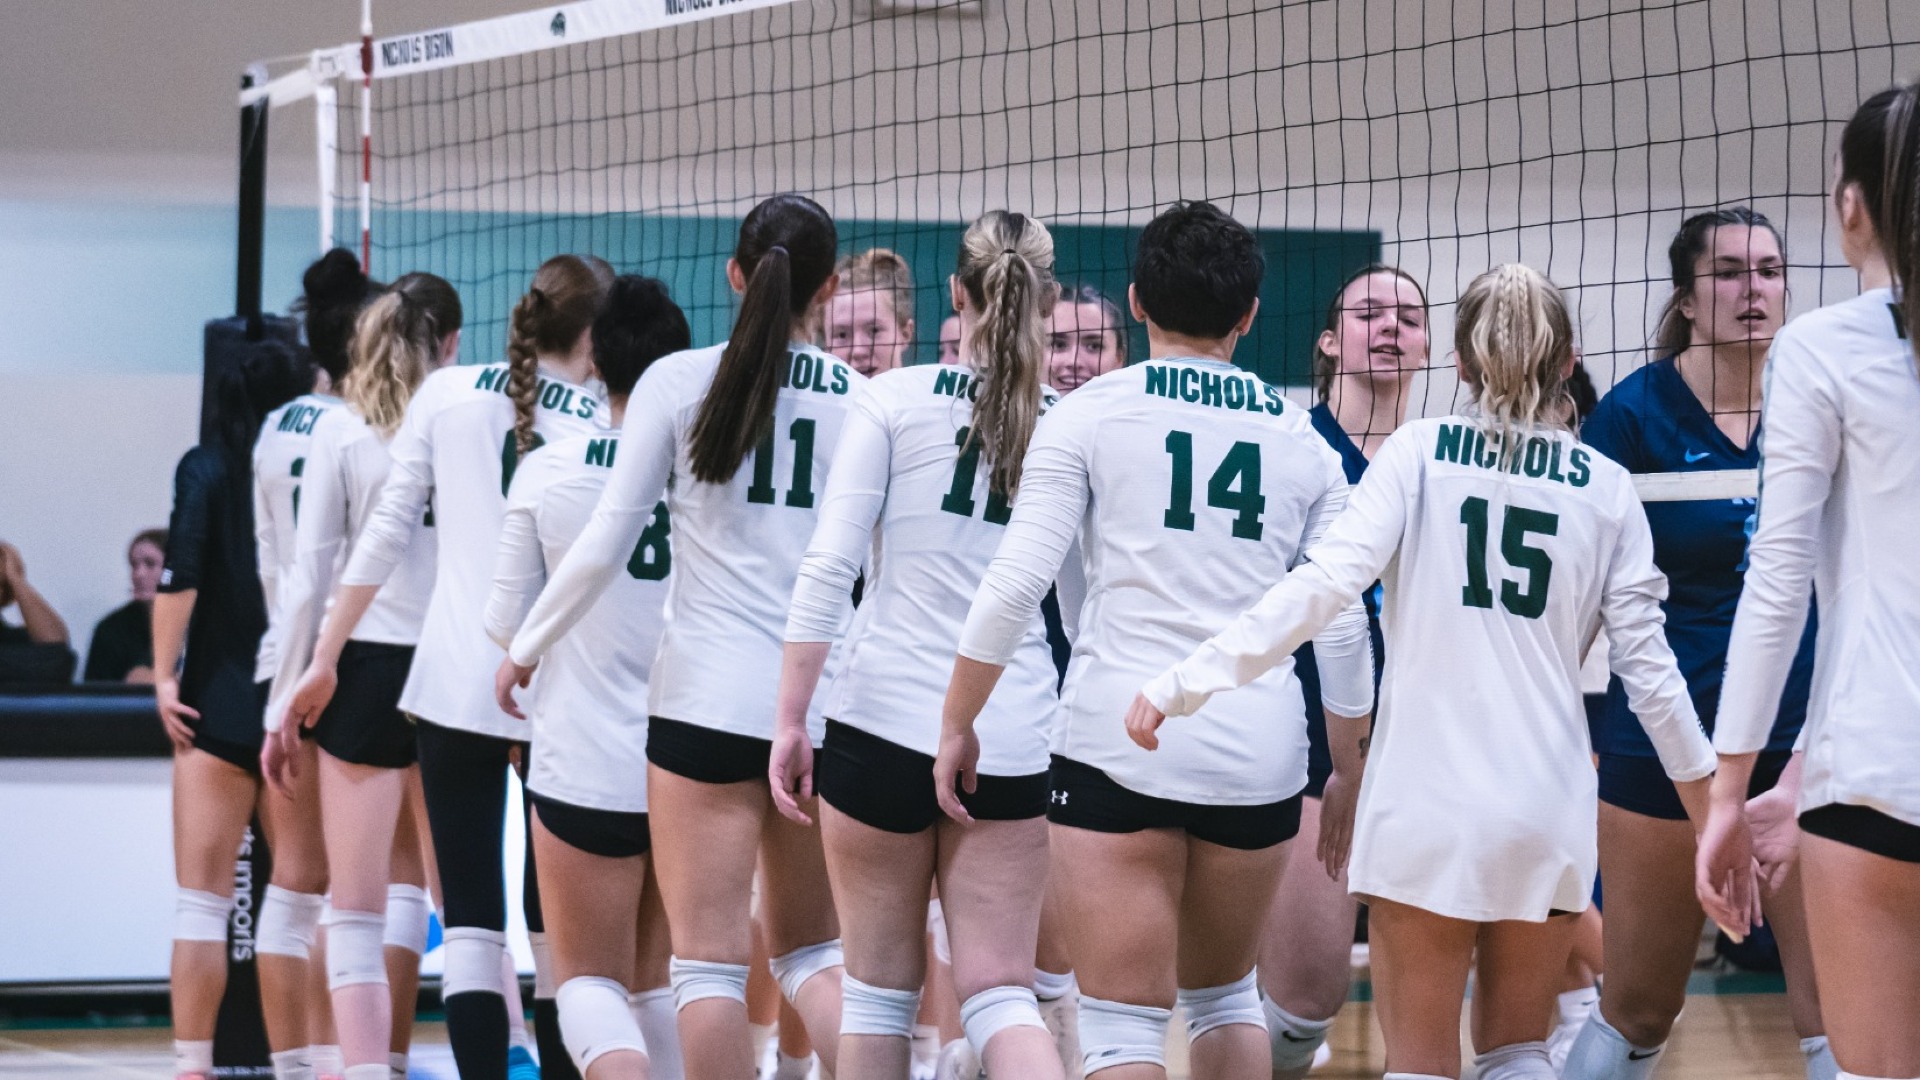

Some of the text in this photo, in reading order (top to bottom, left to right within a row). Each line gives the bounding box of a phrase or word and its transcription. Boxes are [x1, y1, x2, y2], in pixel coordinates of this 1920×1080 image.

[381, 30, 454, 68] NICHOLS BISON
[1144, 364, 1285, 417] NICHOLS
[747, 415, 817, 509] 11
[1163, 429, 1266, 542] 14
[1433, 423, 1592, 488] NICHOLS
[626, 500, 672, 581] 8
[1459, 495, 1560, 620] 15
